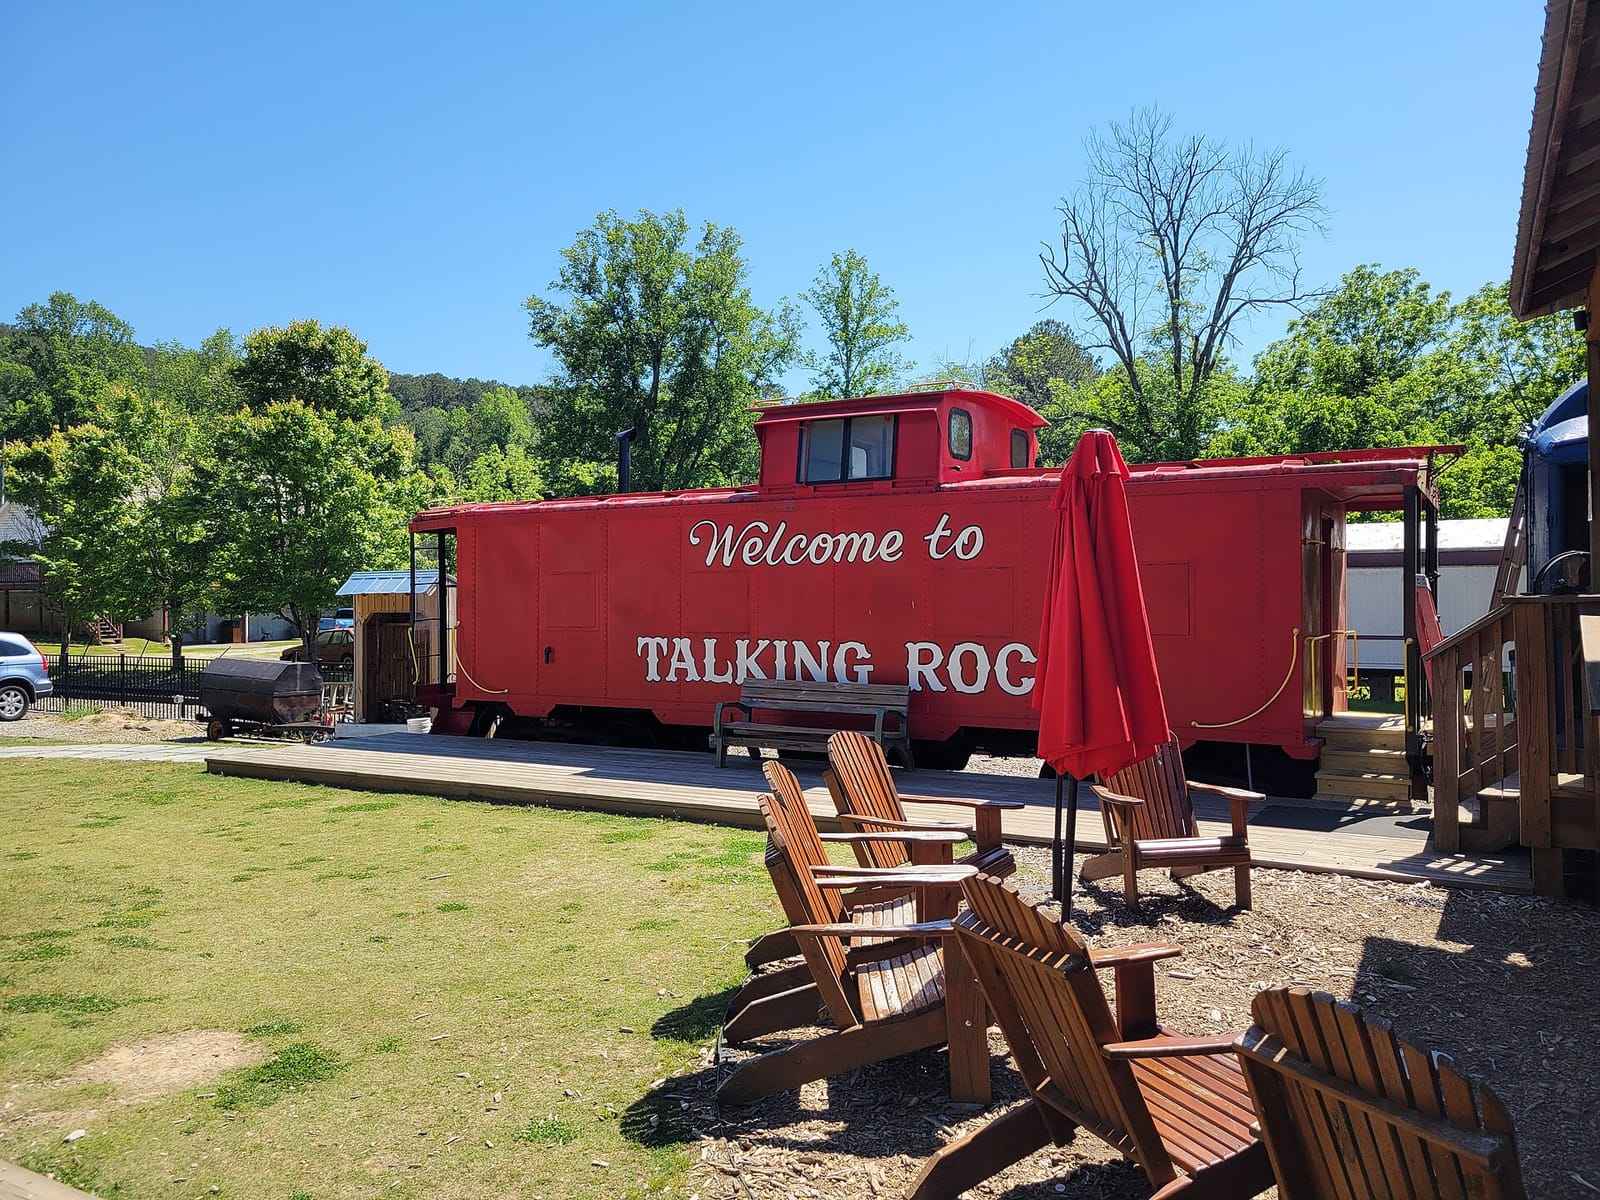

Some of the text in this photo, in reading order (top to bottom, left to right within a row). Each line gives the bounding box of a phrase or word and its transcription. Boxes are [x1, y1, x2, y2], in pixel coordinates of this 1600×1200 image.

[689, 512, 984, 567] Welcome to
[637, 636, 1038, 696] TALKING ROC
